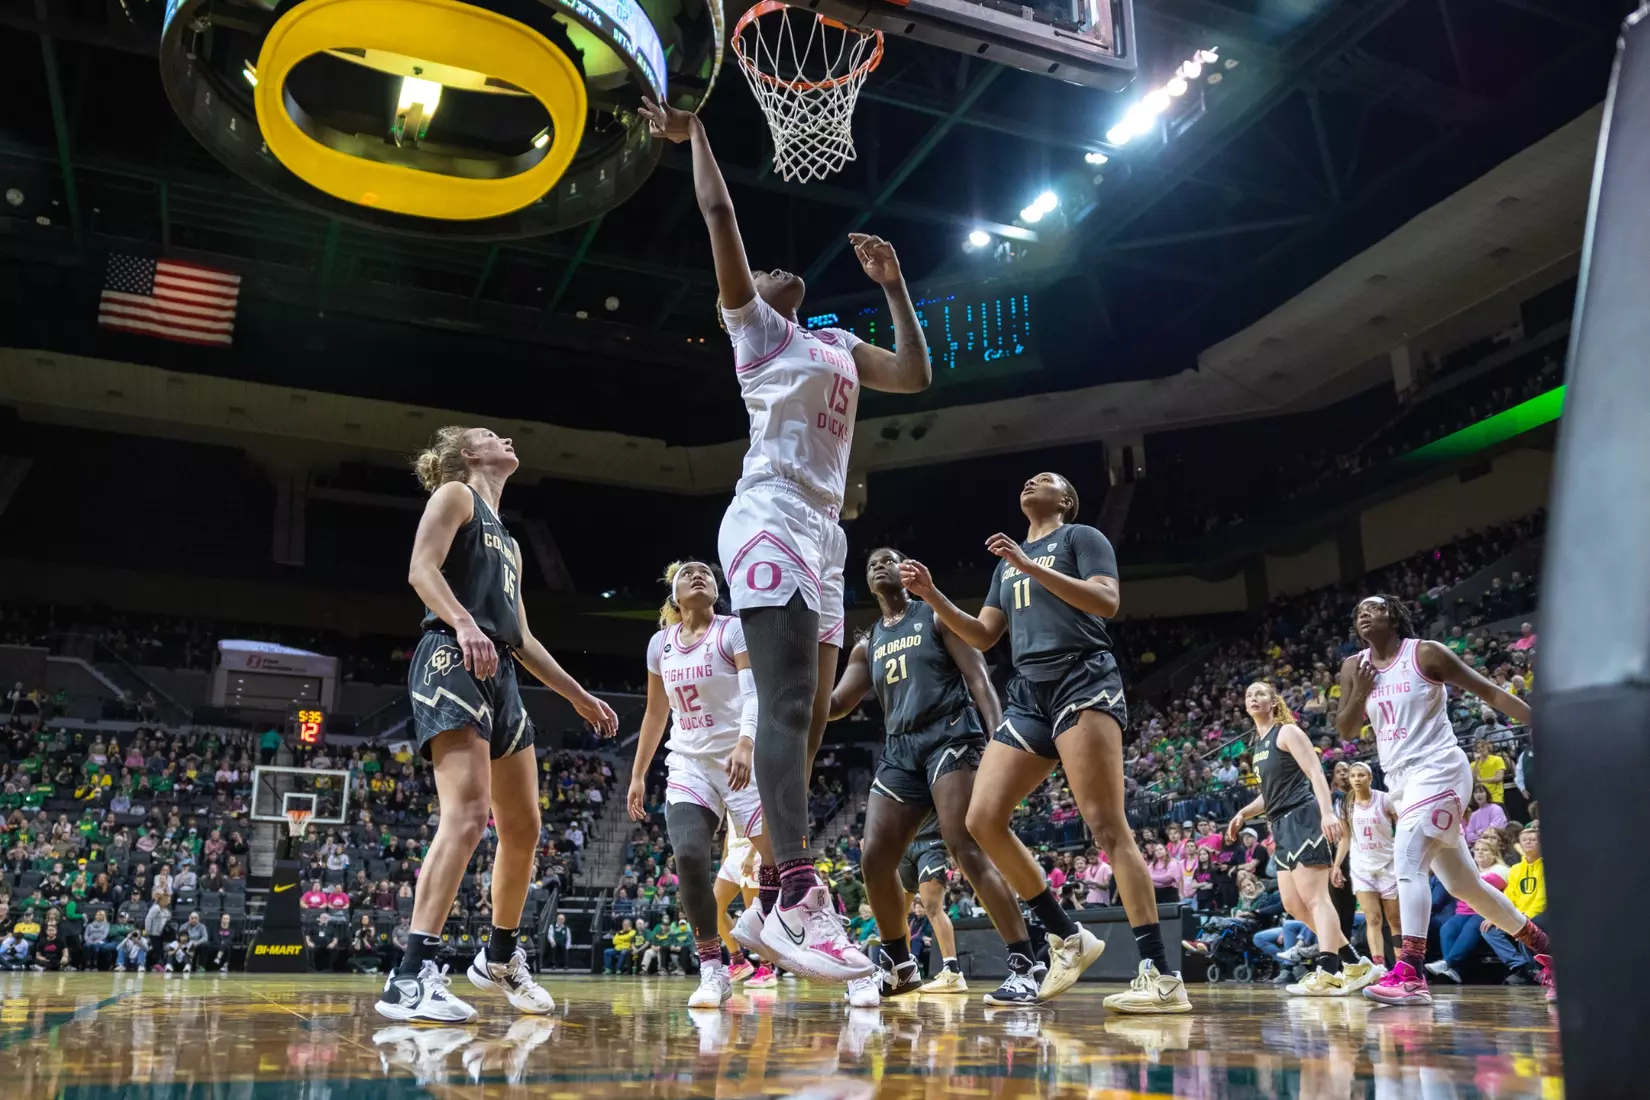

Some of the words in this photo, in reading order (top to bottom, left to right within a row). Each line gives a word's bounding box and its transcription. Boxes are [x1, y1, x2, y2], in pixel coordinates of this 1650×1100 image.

[828, 372, 854, 416] 15
[503, 563, 517, 601] 15
[746, 561, 783, 593] O
[1012, 577, 1031, 610] 11
[873, 634, 922, 663] COLORADO
[664, 664, 713, 683] FIGHTING
[885, 653, 908, 685] 21
[674, 683, 702, 713] 12
[299, 710, 323, 723] 5:35
[679, 714, 714, 731] DUCKS
[1378, 700, 1396, 725] 11
[300, 723, 319, 743] 12
[1363, 825, 1373, 841] 4
[1432, 808, 1453, 831] O
